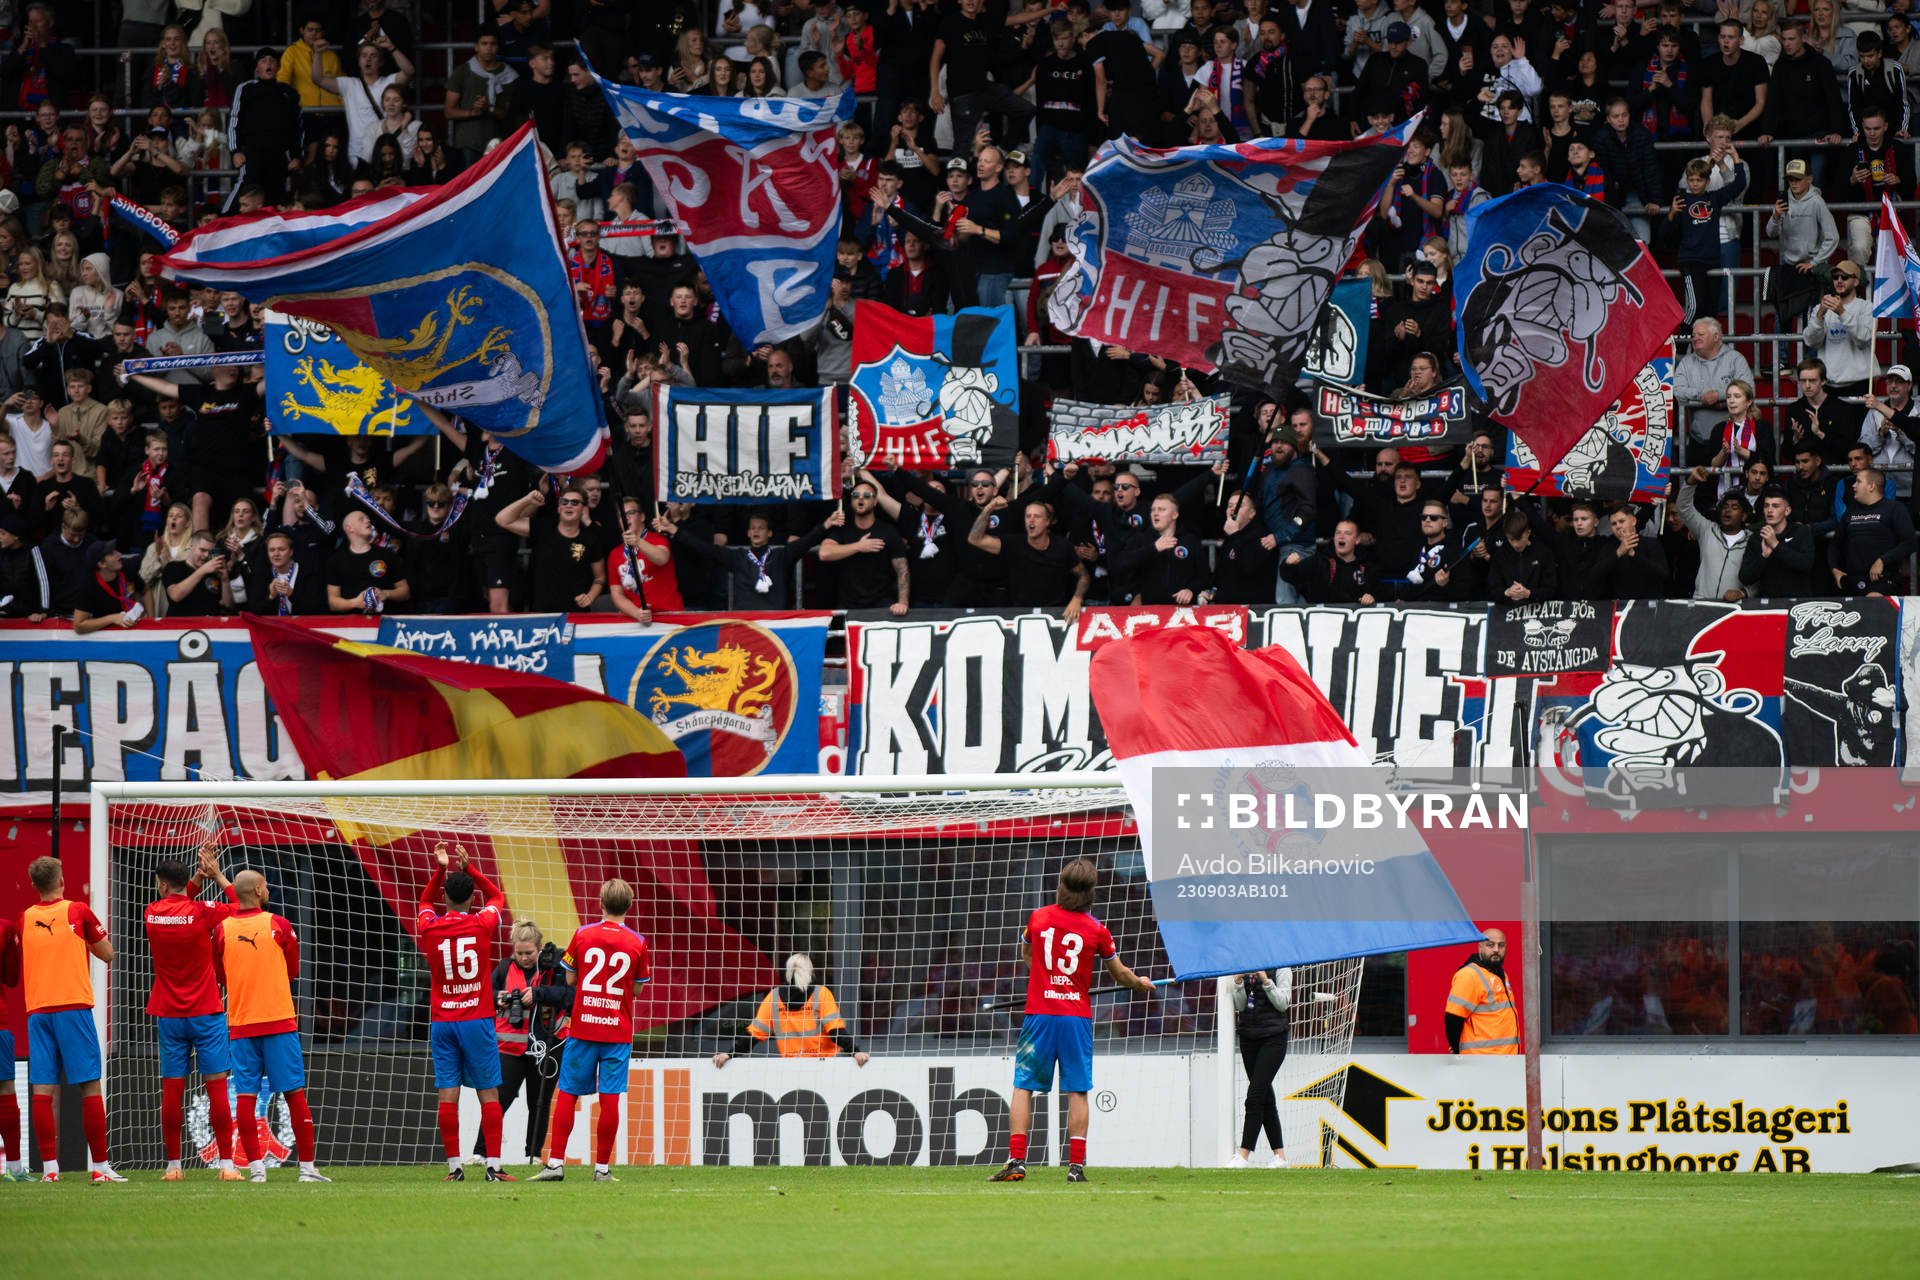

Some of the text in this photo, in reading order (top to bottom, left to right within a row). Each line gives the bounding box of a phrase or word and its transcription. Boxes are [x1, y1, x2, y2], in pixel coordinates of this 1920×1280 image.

[674, 402, 814, 476] HIF
[1505, 599, 1596, 622] SYMPATI FÖR
[1790, 601, 1861, 631] Free
[1496, 645, 1599, 673] DE AVSTÄNGDA
[675, 709, 753, 734] Skånepågarna
[437, 936, 479, 981] 15
[1040, 927, 1084, 976] 13
[582, 947, 632, 996] 22
[580, 1013, 620, 1026] tillmobil
[541, 1067, 1087, 1166] llmob
[1427, 1097, 1851, 1143] Jönsons Plåtslageri
[1467, 1144, 1812, 1173] i Hlsingborg AB
